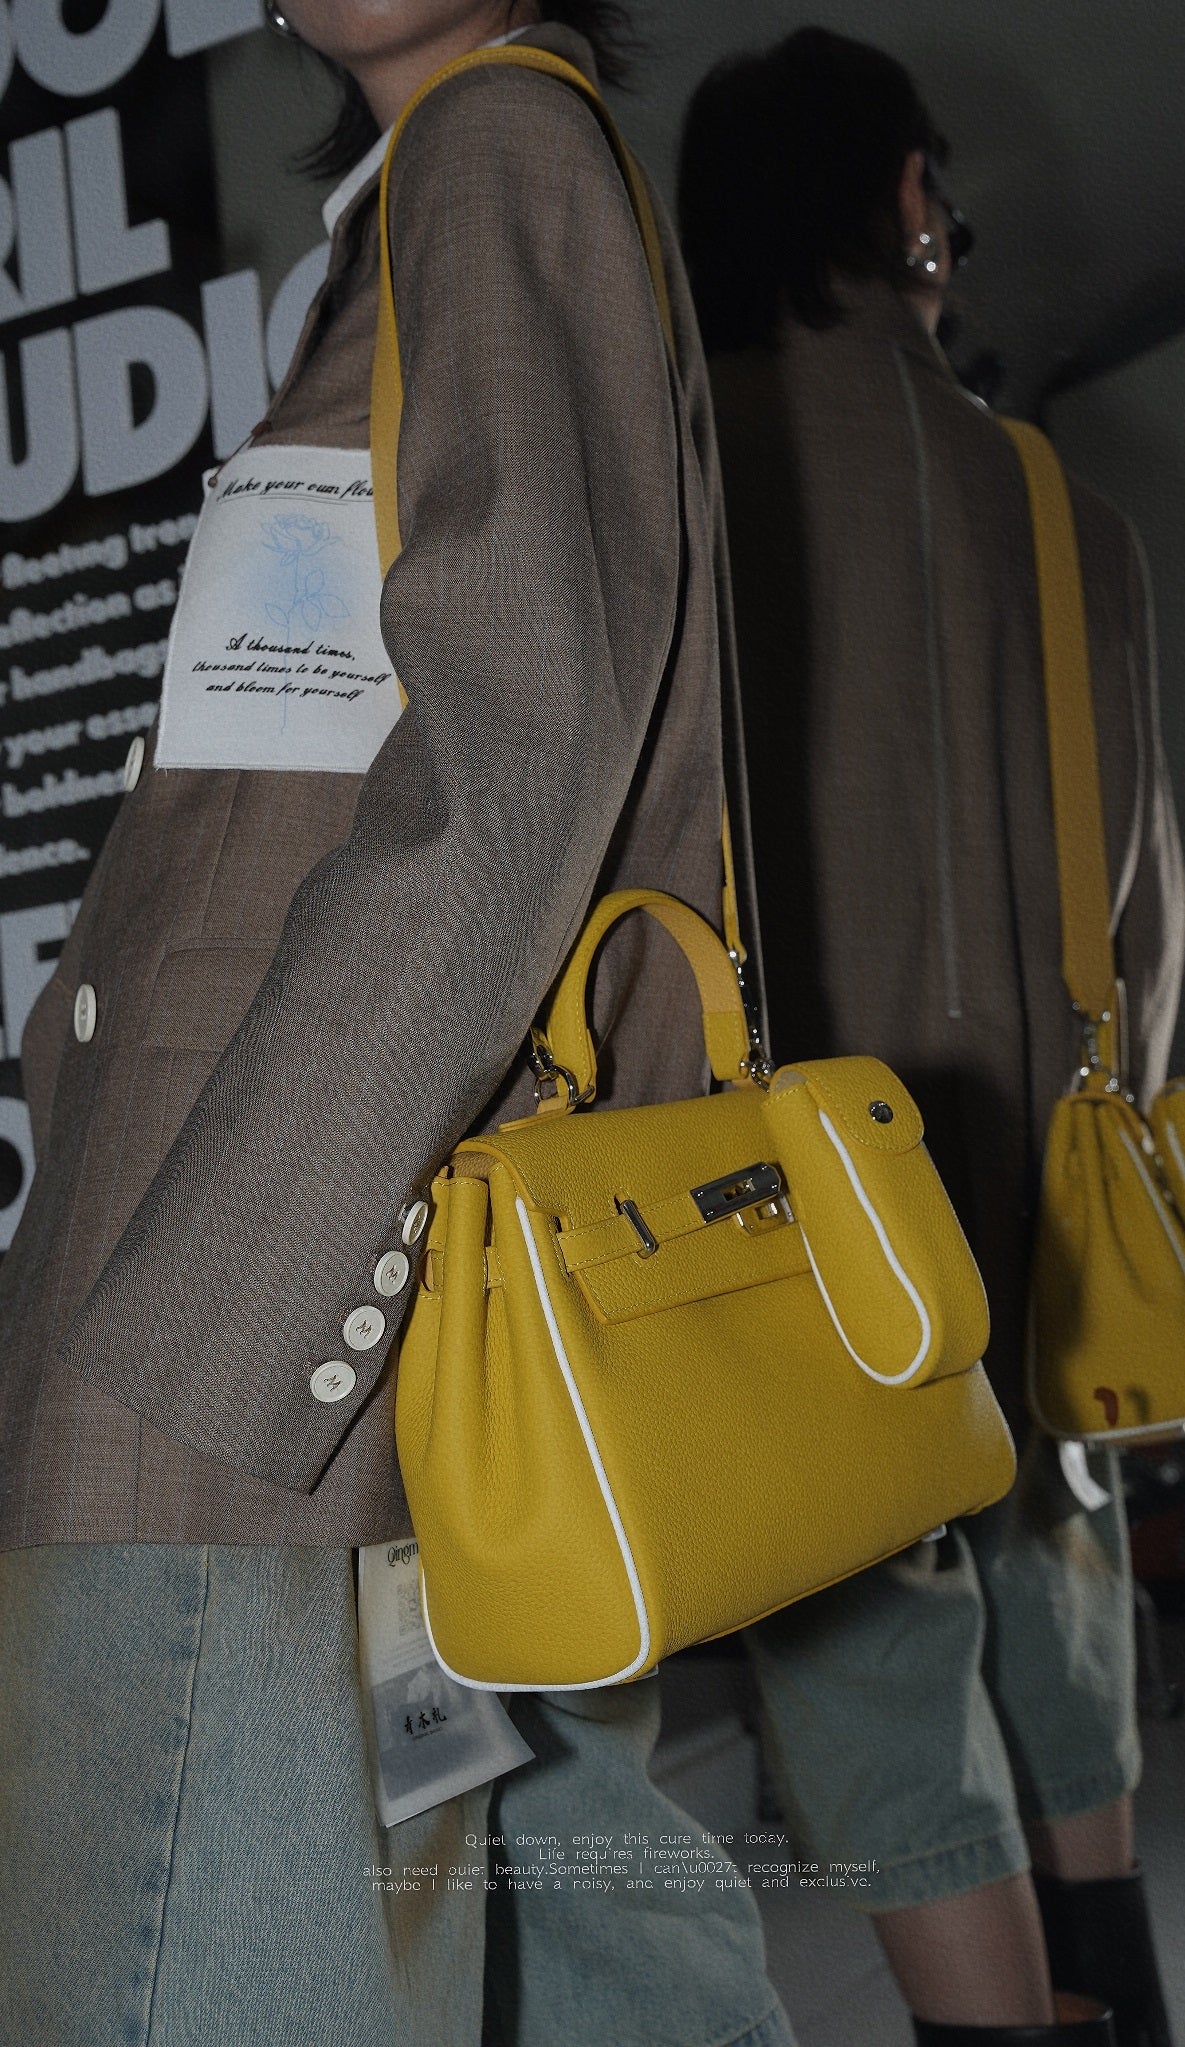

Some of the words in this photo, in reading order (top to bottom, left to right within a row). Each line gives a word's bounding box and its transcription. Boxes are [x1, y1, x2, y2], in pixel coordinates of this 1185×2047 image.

[216, 477, 261, 502] Make
[262, 480, 304, 496] your
[225, 632, 248, 651] A
[247, 636, 315, 655] thousand
[315, 643, 356, 661] times,
[192, 660, 257, 673] thousand
[257, 661, 292, 674] times
[296, 663, 309, 673] to
[312, 663, 328, 675] be
[328, 669, 391, 686] yourself
[205, 681, 236, 692] and
[235, 681, 275, 693] bloom
[276, 682, 300, 696] for
[299, 685, 365, 702] yourself
